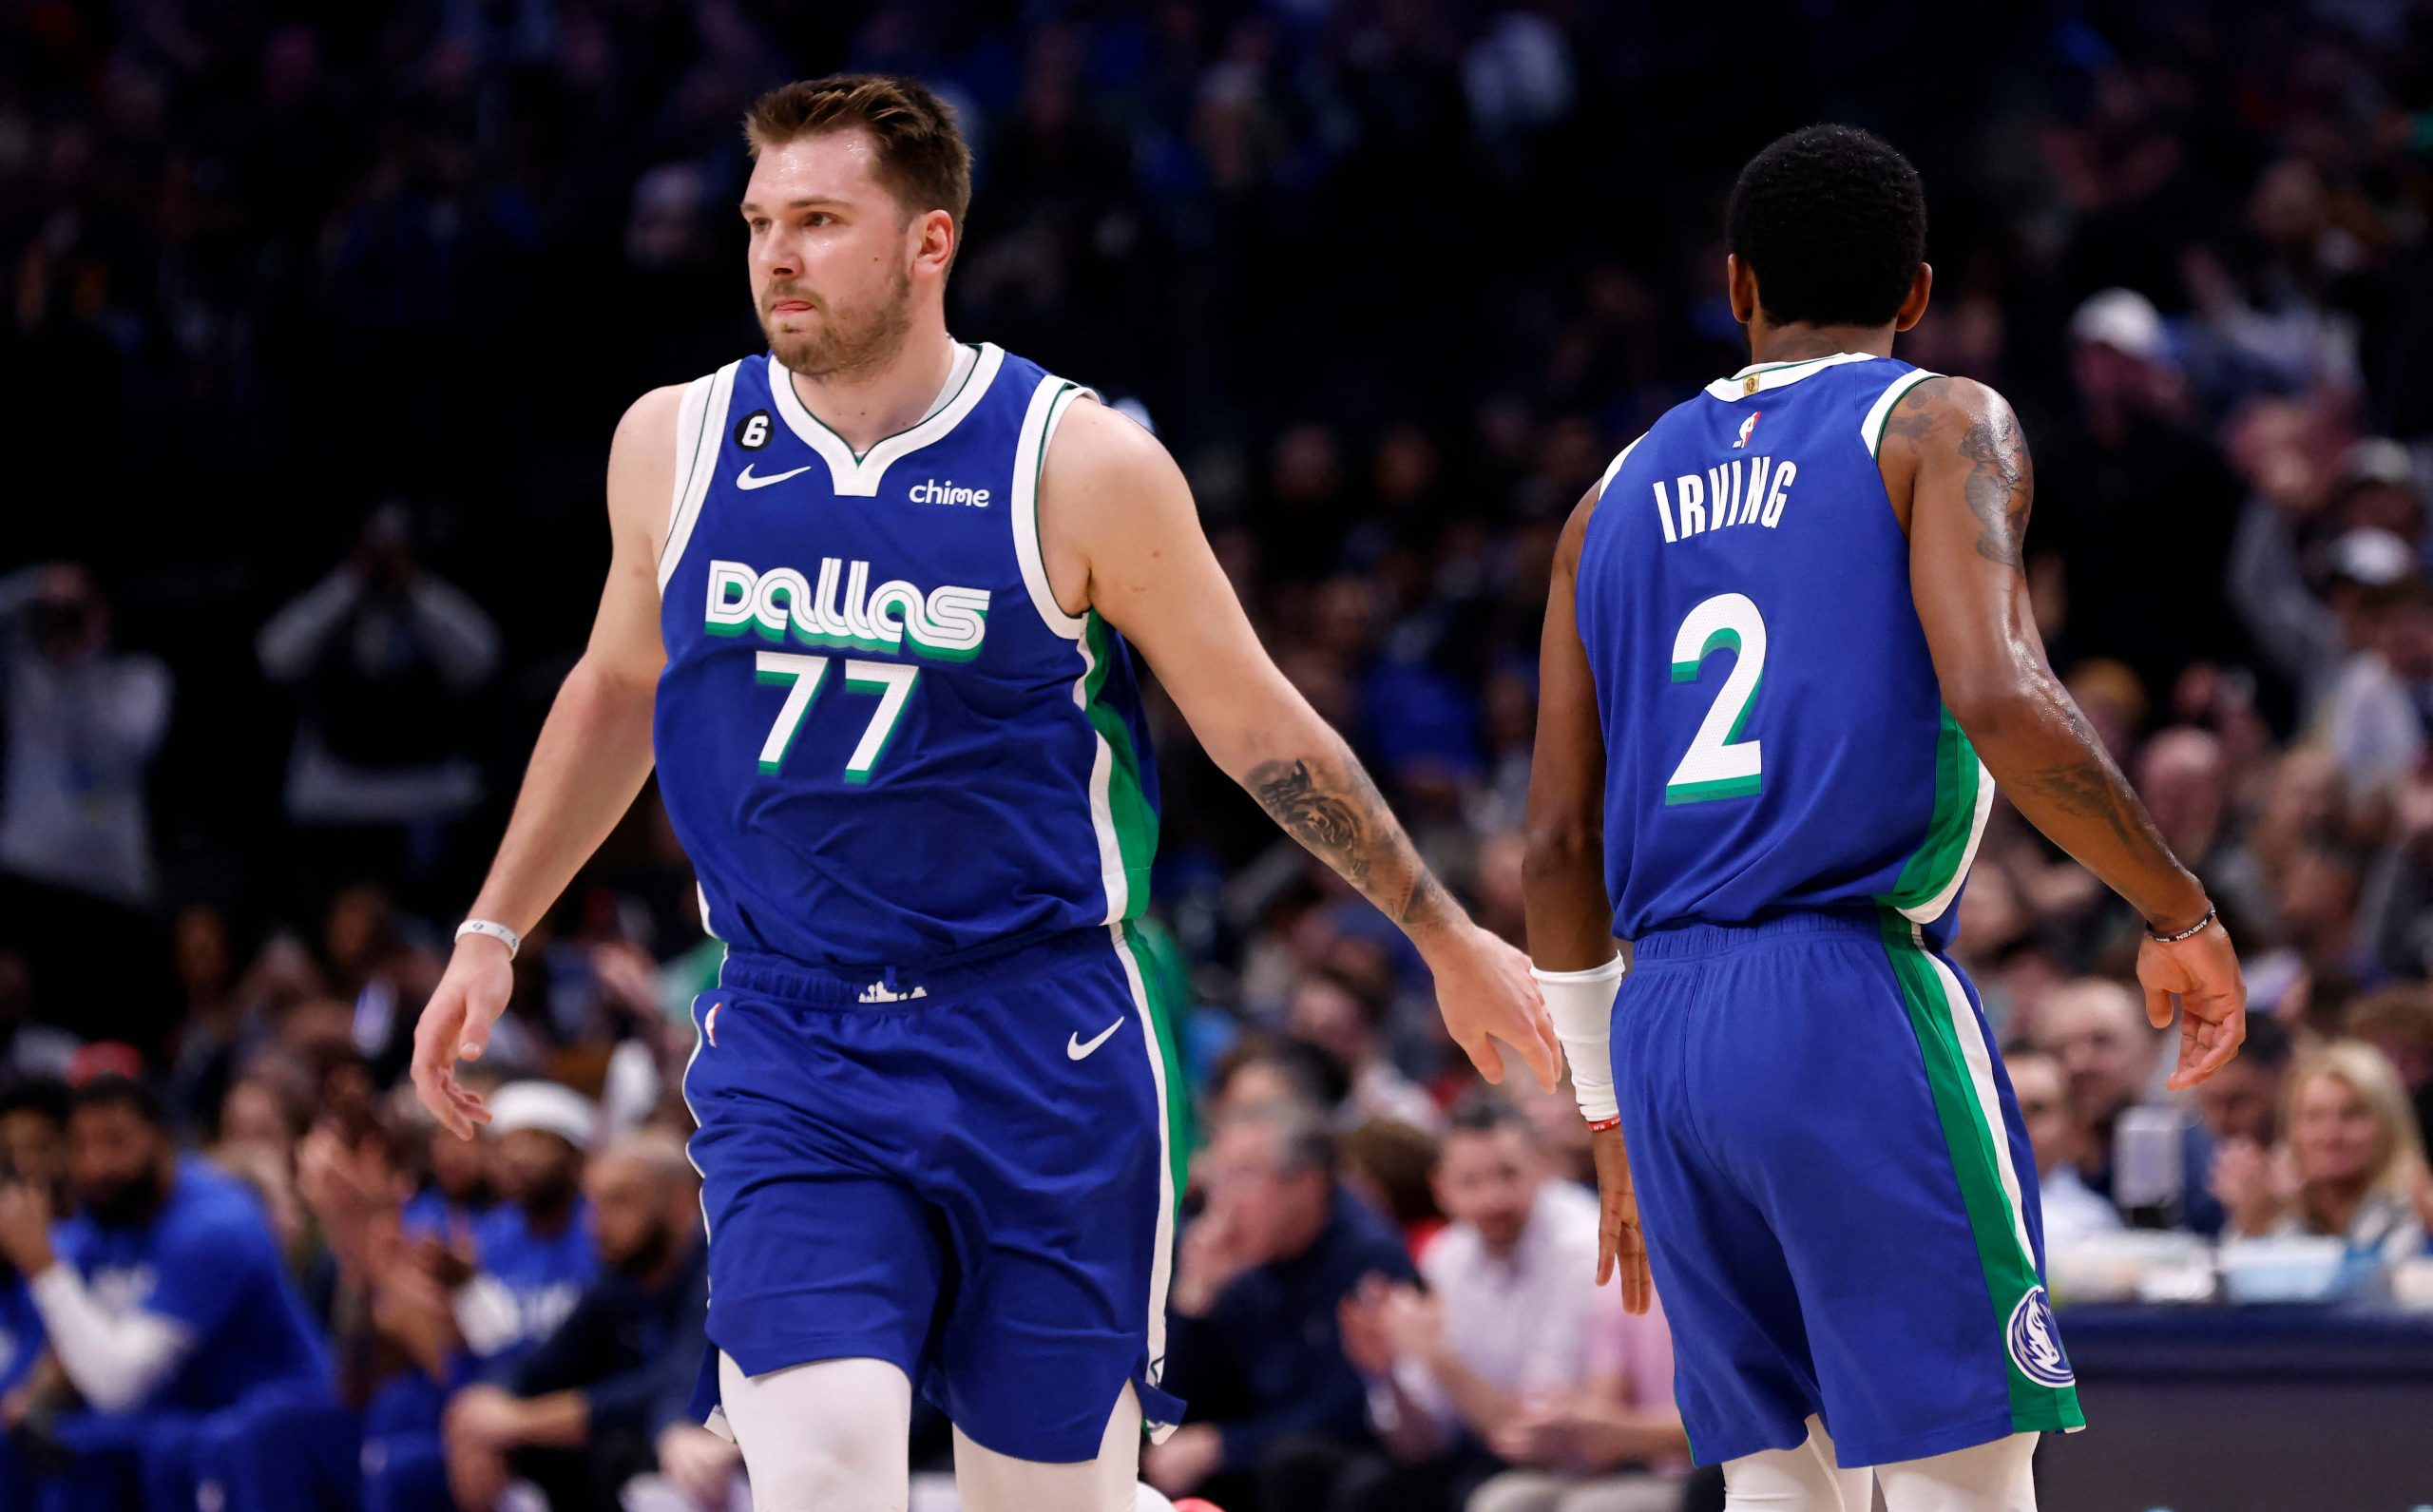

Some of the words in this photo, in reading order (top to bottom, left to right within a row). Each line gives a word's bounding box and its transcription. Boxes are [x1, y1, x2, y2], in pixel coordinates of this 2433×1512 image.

[742, 415, 768, 447] 6
[909, 479, 990, 507] chime
[1653, 457, 1797, 544] IRVING
[756, 651, 919, 784] 77
[1665, 592, 1767, 805] 2
